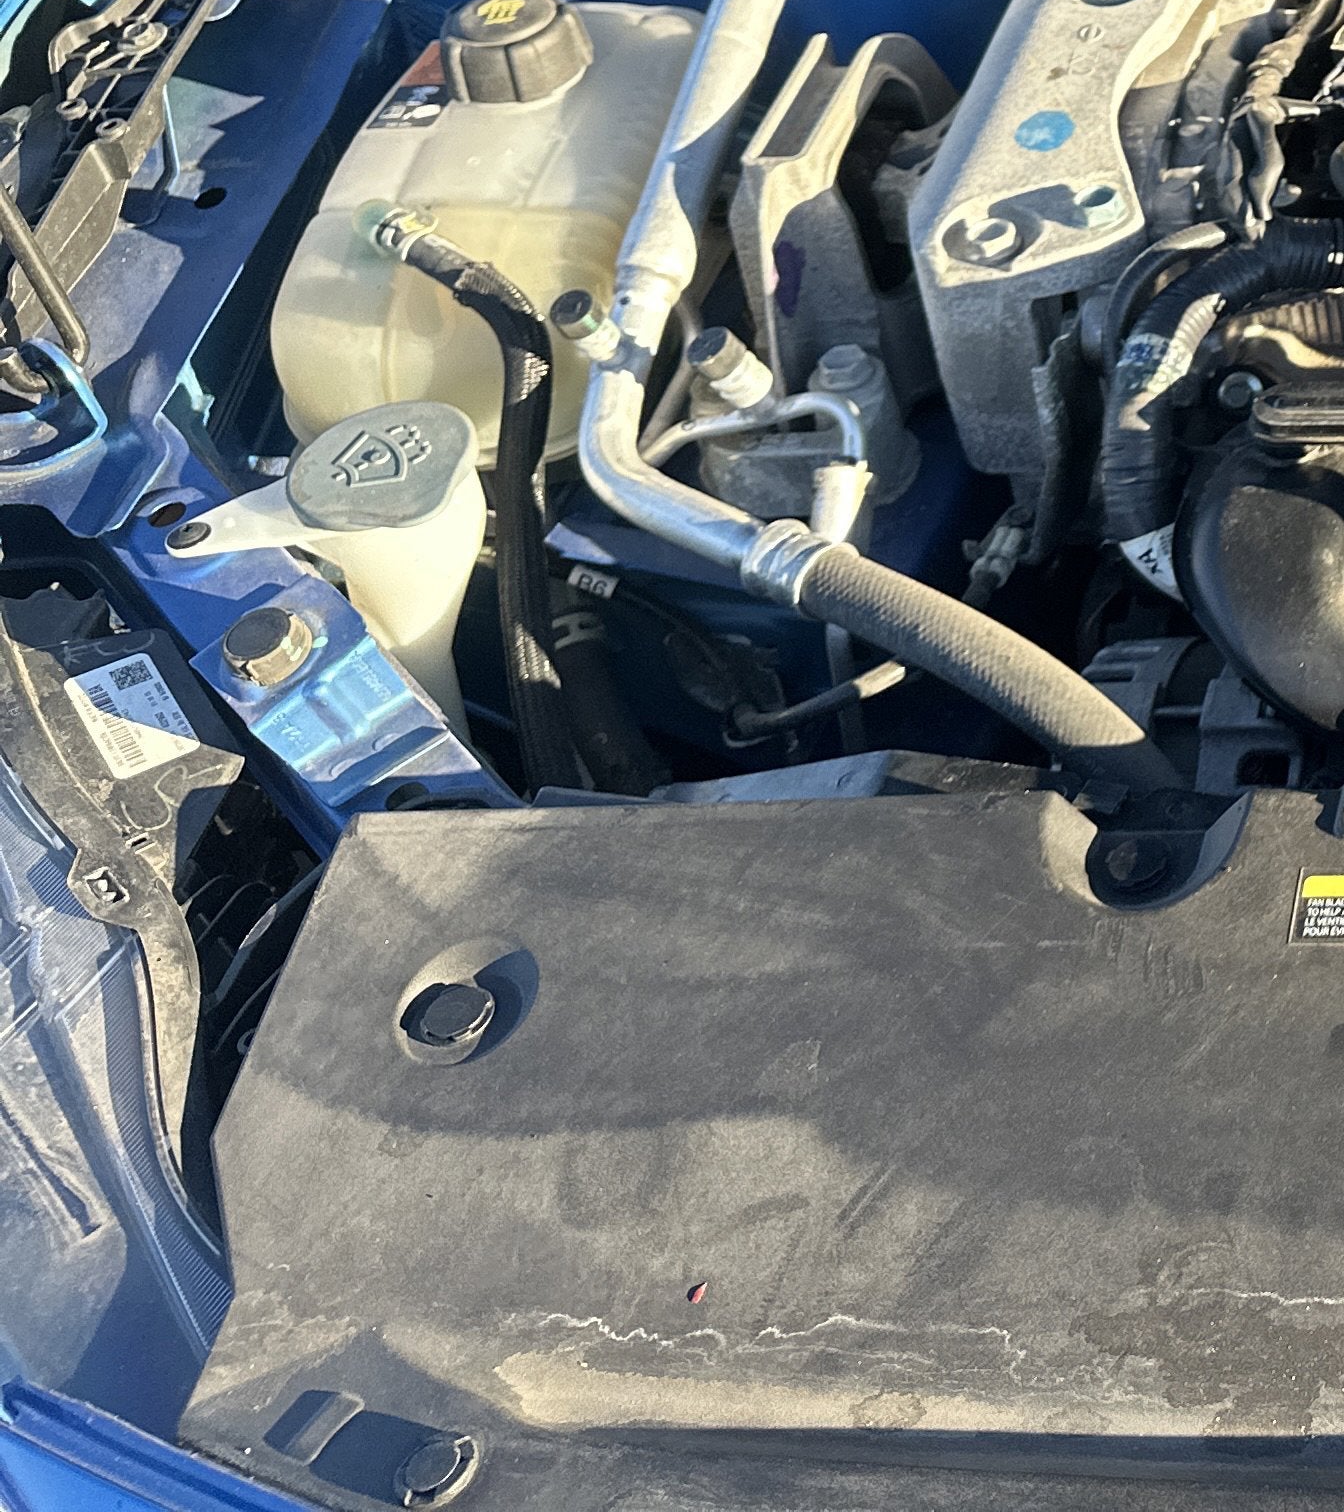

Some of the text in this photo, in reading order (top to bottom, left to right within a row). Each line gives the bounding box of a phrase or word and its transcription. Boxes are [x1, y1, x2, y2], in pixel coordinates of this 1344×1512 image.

[1307, 898, 1326, 907] FAN
[1307, 907, 1320, 916] TO
[1320, 906, 1341, 916] HELP
[1305, 916, 1315, 926] LE
[1303, 926, 1329, 936] POUR
